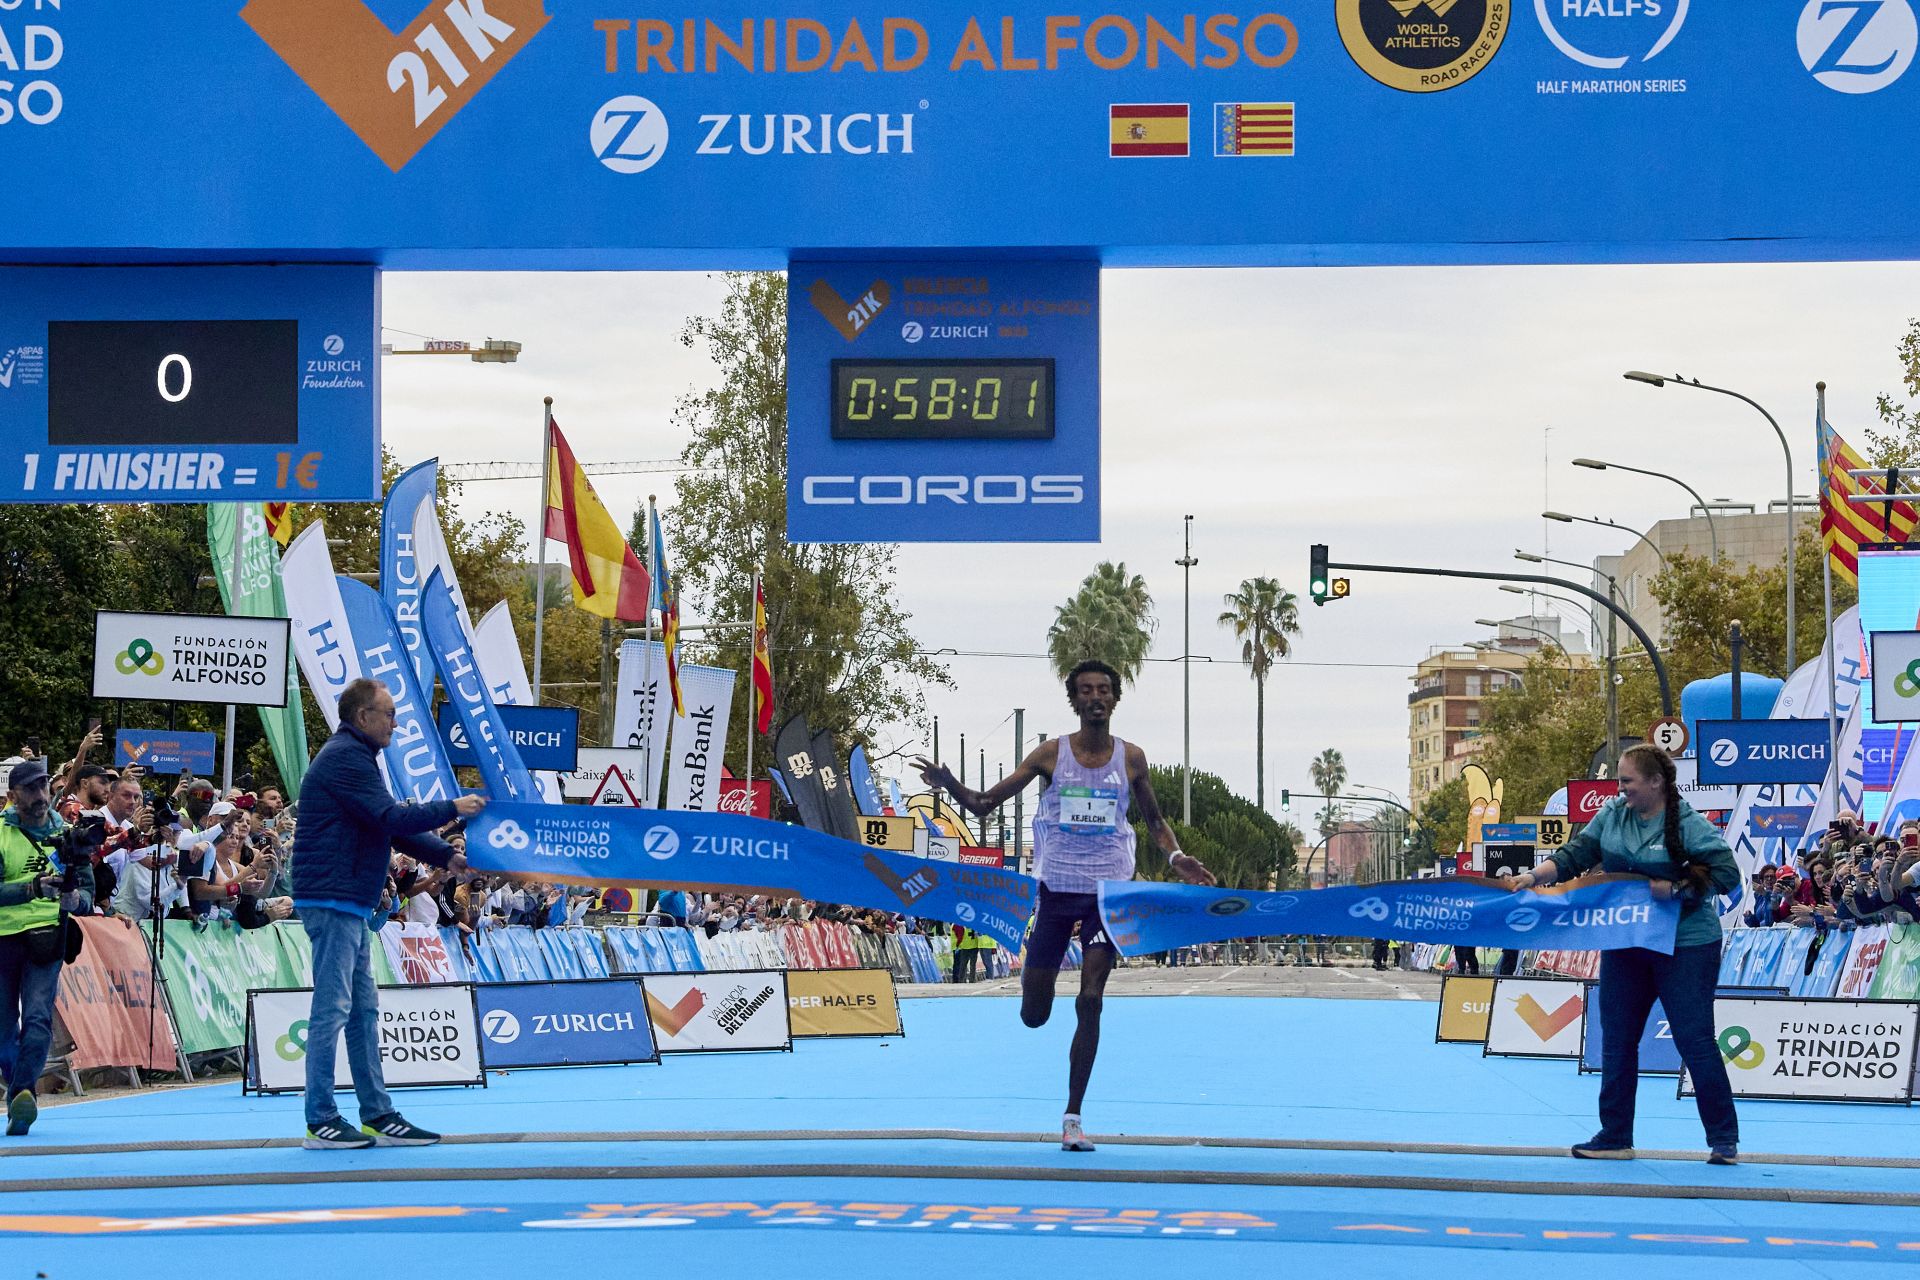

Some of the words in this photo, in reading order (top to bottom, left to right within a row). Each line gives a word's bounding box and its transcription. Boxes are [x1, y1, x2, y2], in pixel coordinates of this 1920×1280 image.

[1561, 0, 1662, 17] HALFS
[1397, 24, 1449, 35] WORLD
[593, 17, 930, 74] TRINIDAD
[949, 13, 1299, 70] ALFONSO
[1385, 37, 1461, 48] ATHLETICS
[1421, 68, 1460, 86] ROAD
[1461, 40, 1492, 73] RACE
[1487, 3, 1503, 41] 2025
[387, 0, 515, 128] 21K
[1536, 81, 1569, 94] HALF
[1571, 80, 1641, 93] MARATHON
[1644, 79, 1687, 92] SERIES
[696, 112, 915, 156] ZURICH
[847, 291, 883, 330] 21K
[929, 326, 989, 338] ZURICH
[17, 346, 44, 355] ASPAS
[307, 360, 361, 372] ZURICH
[157, 354, 192, 402] 0
[302, 374, 365, 389] Foundation
[23, 453, 38, 491] 1
[54, 452, 224, 490] FINISHER
[276, 452, 324, 489] 1€
[802, 475, 1084, 505] COROS
[174, 636, 267, 649] FUNDACIÓN
[172, 649, 267, 668] TRINIDAD
[171, 668, 266, 686] ALFONSO
[1661, 730, 1672, 744] 5
[683, 704, 715, 811] ixaBank
[1747, 744, 1825, 760] ZURICH
[1087, 802, 1092, 810] 1
[535, 819, 611, 830] FUNDACIÓN
[1071, 815, 1106, 823] KEJELCHA
[535, 829, 611, 845] TRINIDAD
[534, 845, 610, 860] ALFONSO
[692, 835, 790, 861] ZURICH
[1489, 850, 1503, 859] KM
[963, 854, 999, 865] ENERVIT
[902, 873, 932, 899] 21K
[948, 868, 1030, 900] VALENCIA
[1396, 901, 1473, 922] TRINIDAD
[1552, 905, 1650, 927] ZURICH
[981, 912, 1021, 944] ZURICH
[1393, 917, 1470, 931] ALFONSO
[707, 985, 748, 1020] VALENCIA
[724, 1019, 744, 1036] DEL
[738, 985, 775, 1022] RUNNING
[717, 997, 748, 1028] CIUDAD
[533, 1011, 634, 1034] ZURICH
[1780, 1022, 1902, 1036] FUNDACIÓN
[1777, 1039, 1901, 1059] TRINIDAD
[1772, 1060, 1898, 1079] ALFONSO
